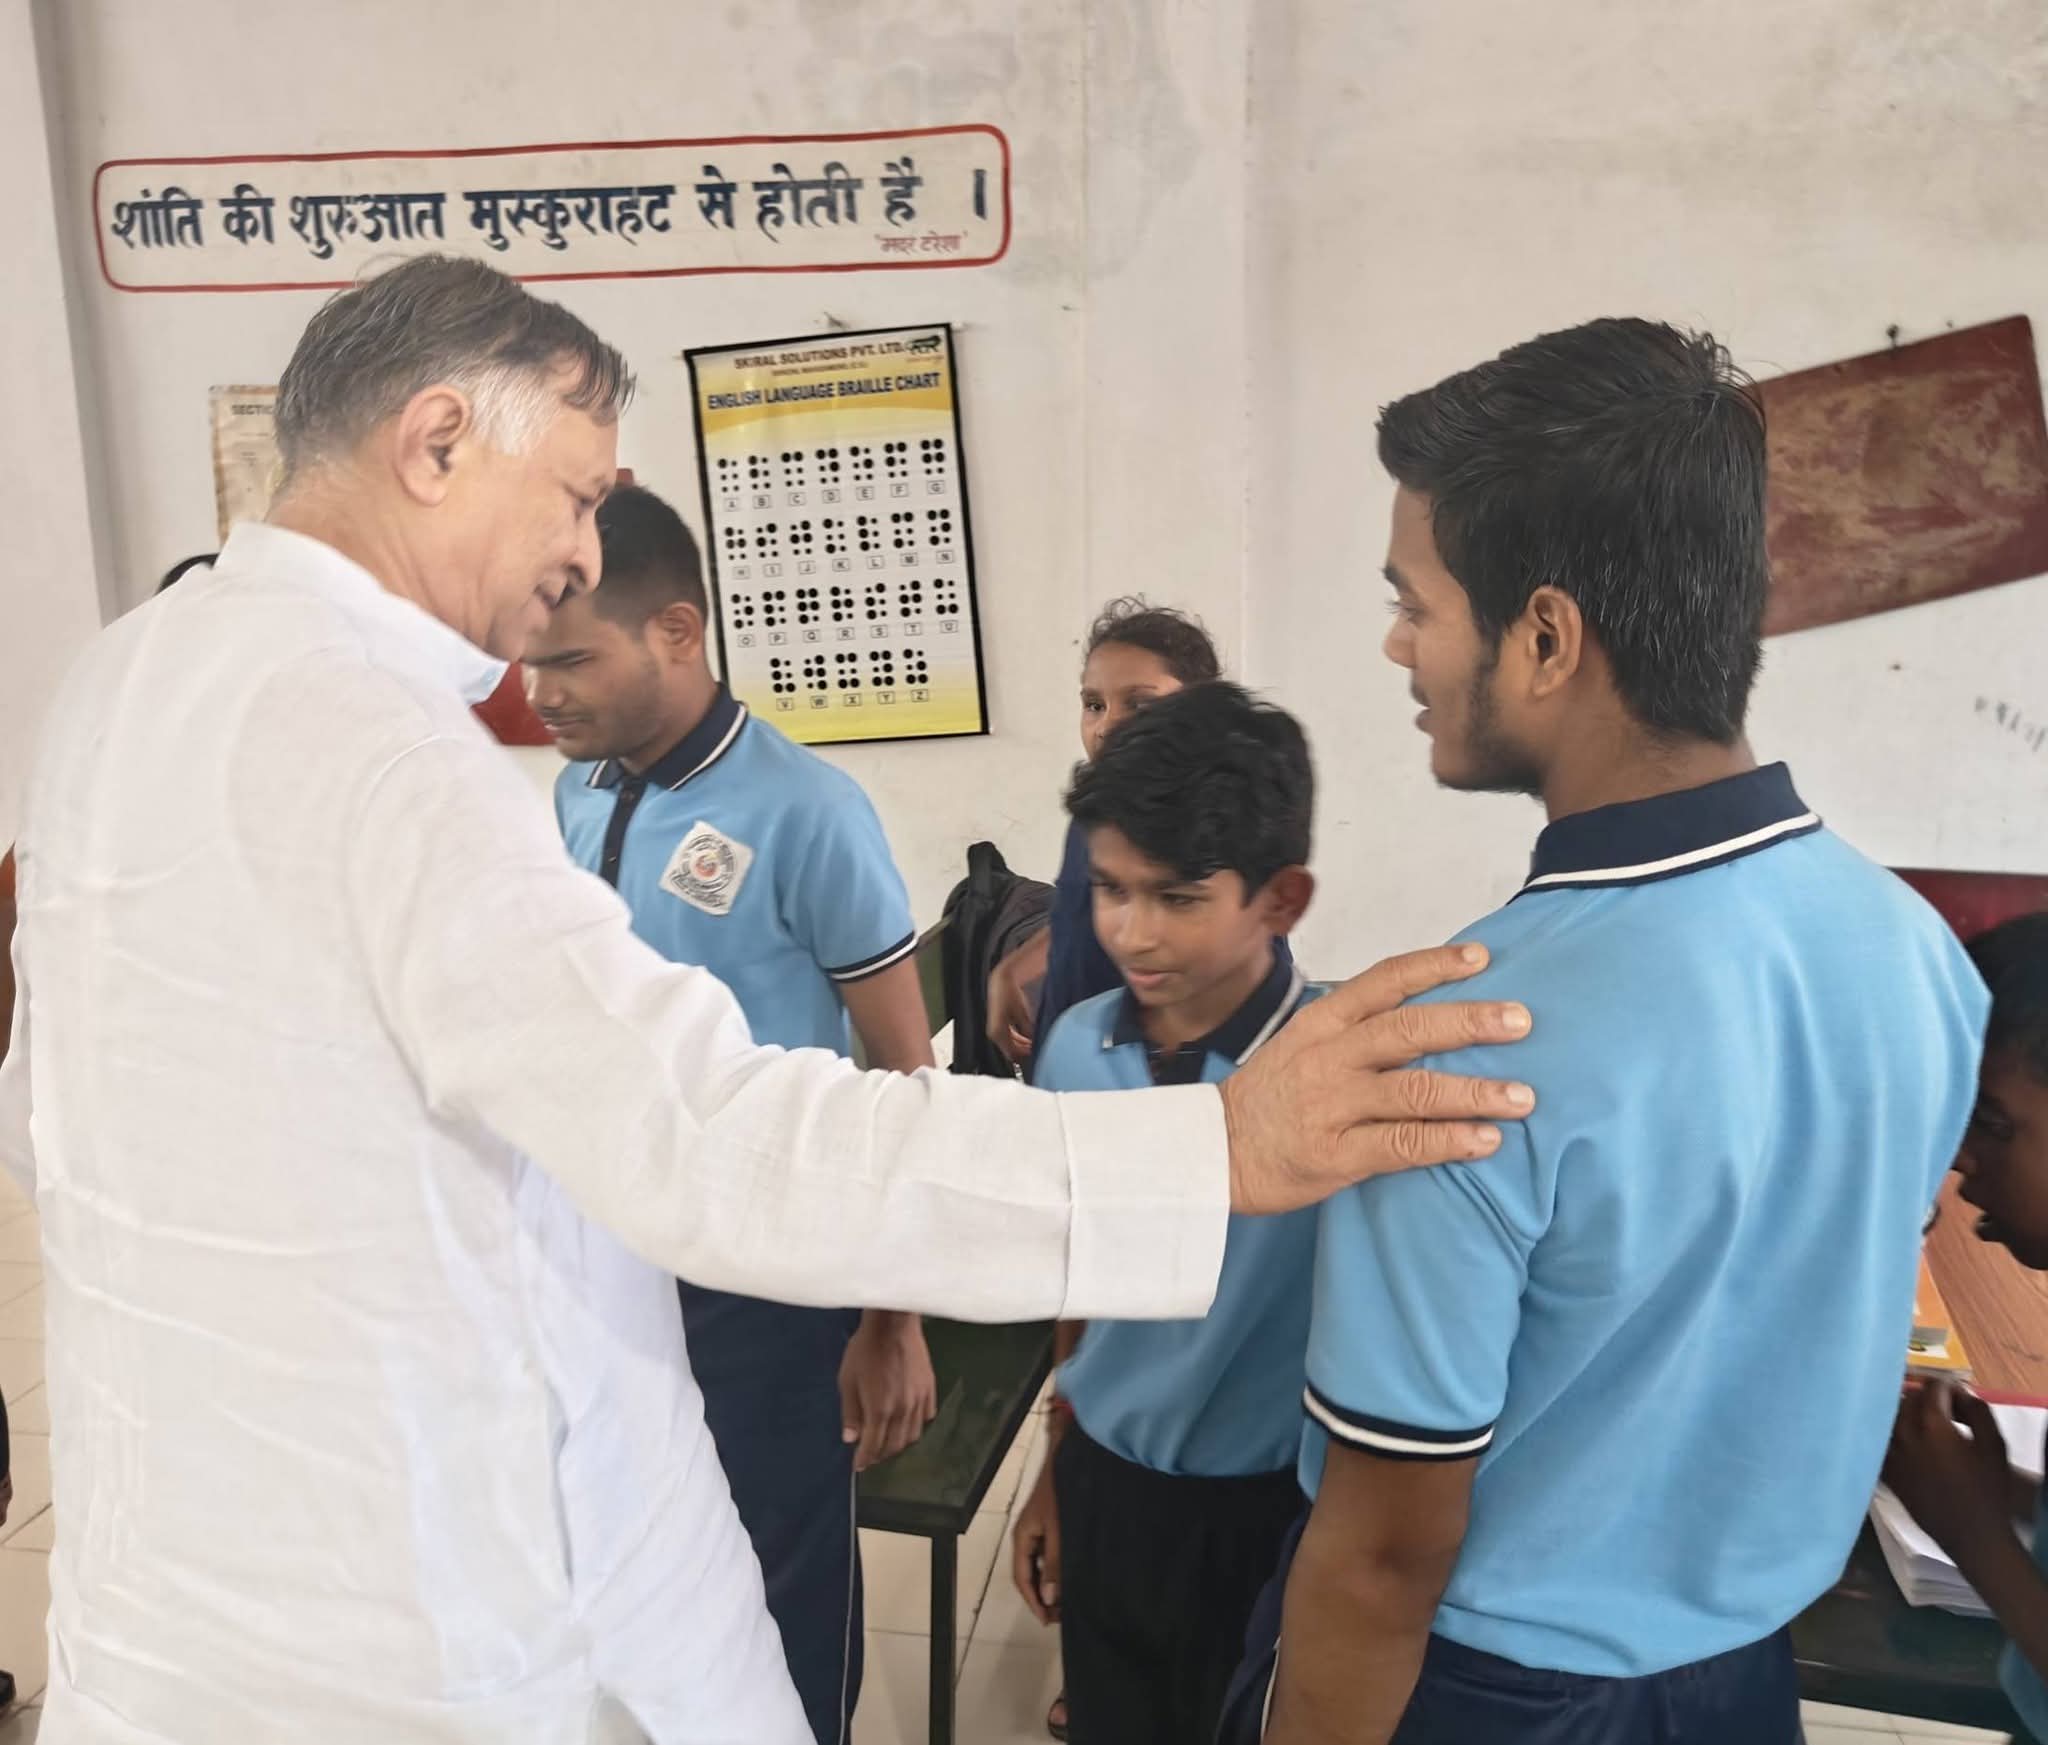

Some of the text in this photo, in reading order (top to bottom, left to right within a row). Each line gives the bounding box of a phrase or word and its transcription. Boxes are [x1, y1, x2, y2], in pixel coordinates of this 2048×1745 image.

[111, 186, 203, 249] शांति
[219, 184, 275, 244] की
[290, 193, 446, 260] शुरुआत
[463, 184, 676, 251] मुस्कुराहट
[694, 165, 738, 229] से
[752, 162, 864, 243] होती
[781, 347, 848, 365] SOLUTIONS
[850, 343, 875, 359] PVT.
[707, 371, 941, 410] ENGLISH LANGUAGE BRAILLE CHART
